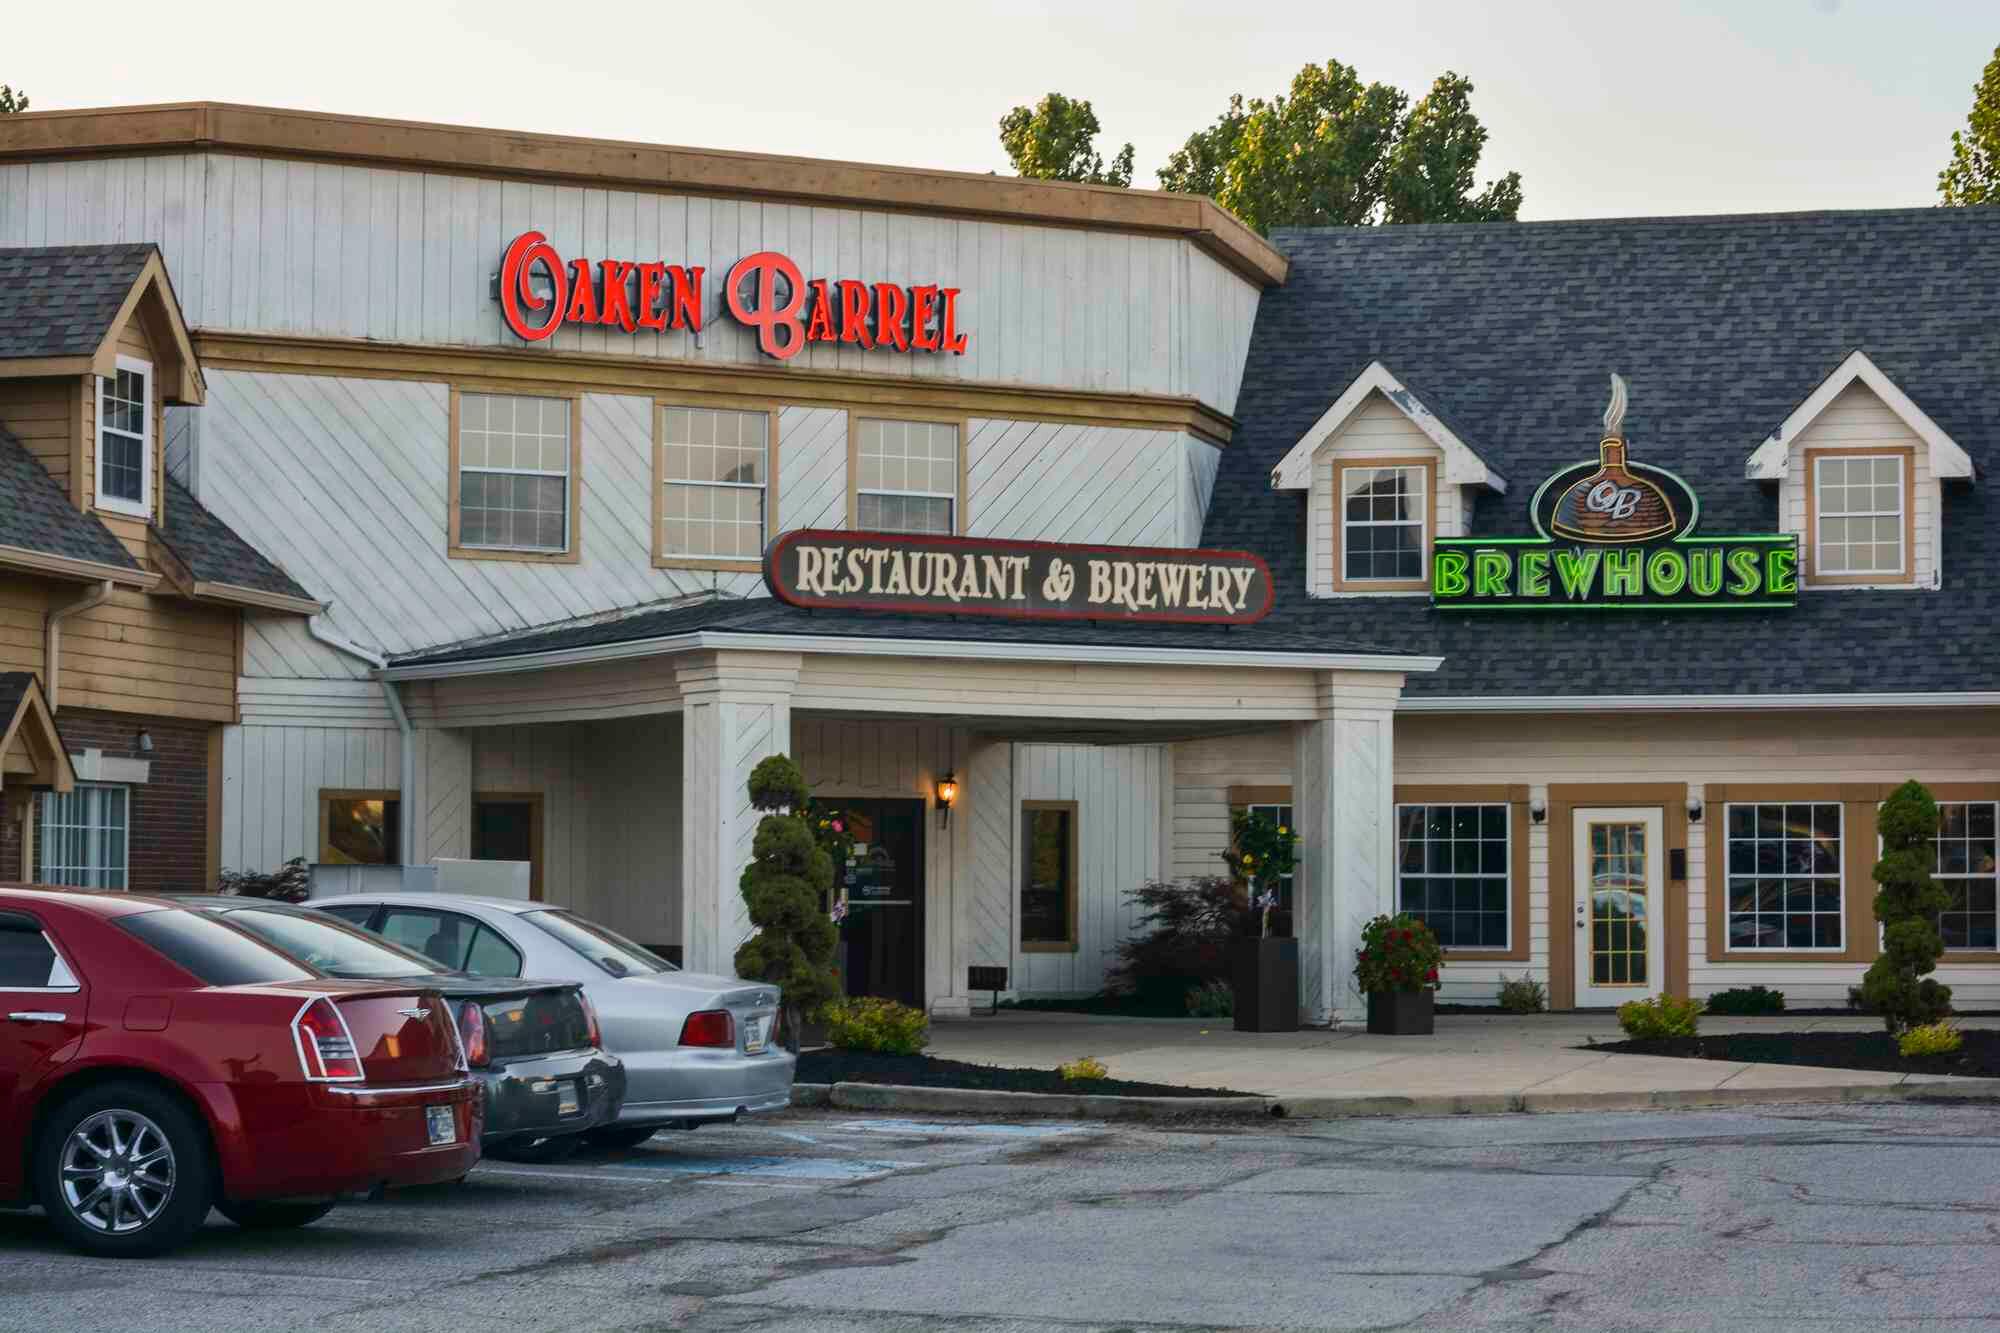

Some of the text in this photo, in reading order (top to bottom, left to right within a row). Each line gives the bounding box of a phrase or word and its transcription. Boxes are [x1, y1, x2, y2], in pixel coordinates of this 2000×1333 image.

[500, 230, 967, 360] OAKEN BARREL
[796, 546, 1255, 614] RESTAURANT & BREWERY
[1434, 548, 1797, 601] BREWHOUSE
